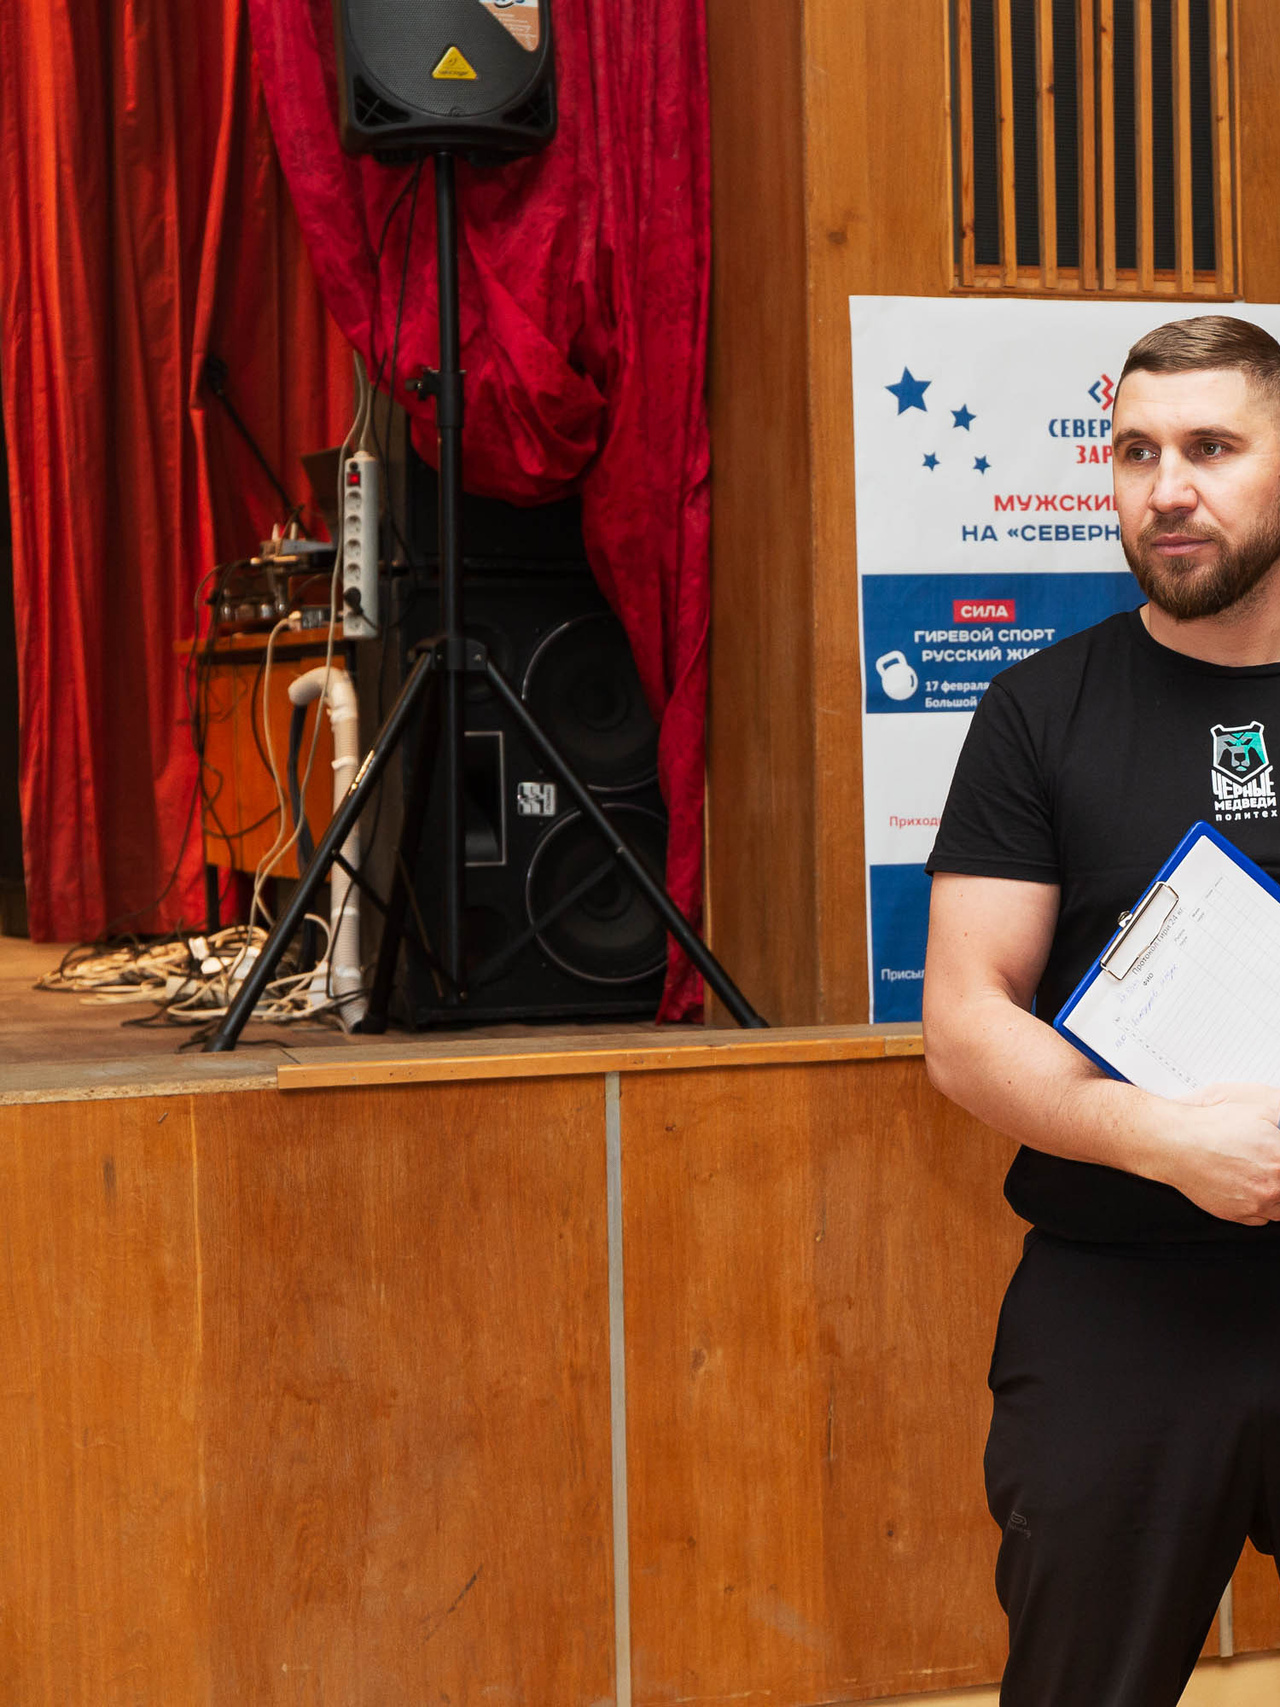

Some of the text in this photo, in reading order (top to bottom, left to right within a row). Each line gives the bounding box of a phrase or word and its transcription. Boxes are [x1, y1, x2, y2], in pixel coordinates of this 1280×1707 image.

[961, 525, 999, 542] НА
[960, 605, 1009, 618] СИЛА
[914, 627, 1056, 643] ГИРЕВОЙ СПОРТ
[921, 646, 1041, 662] РУССКИЙ ЖИ
[925, 680, 939, 692] 17
[925, 696, 978, 709] Большой
[1214, 797, 1277, 811] МЕДВЕДИ
[1215, 810, 1278, 821] политех
